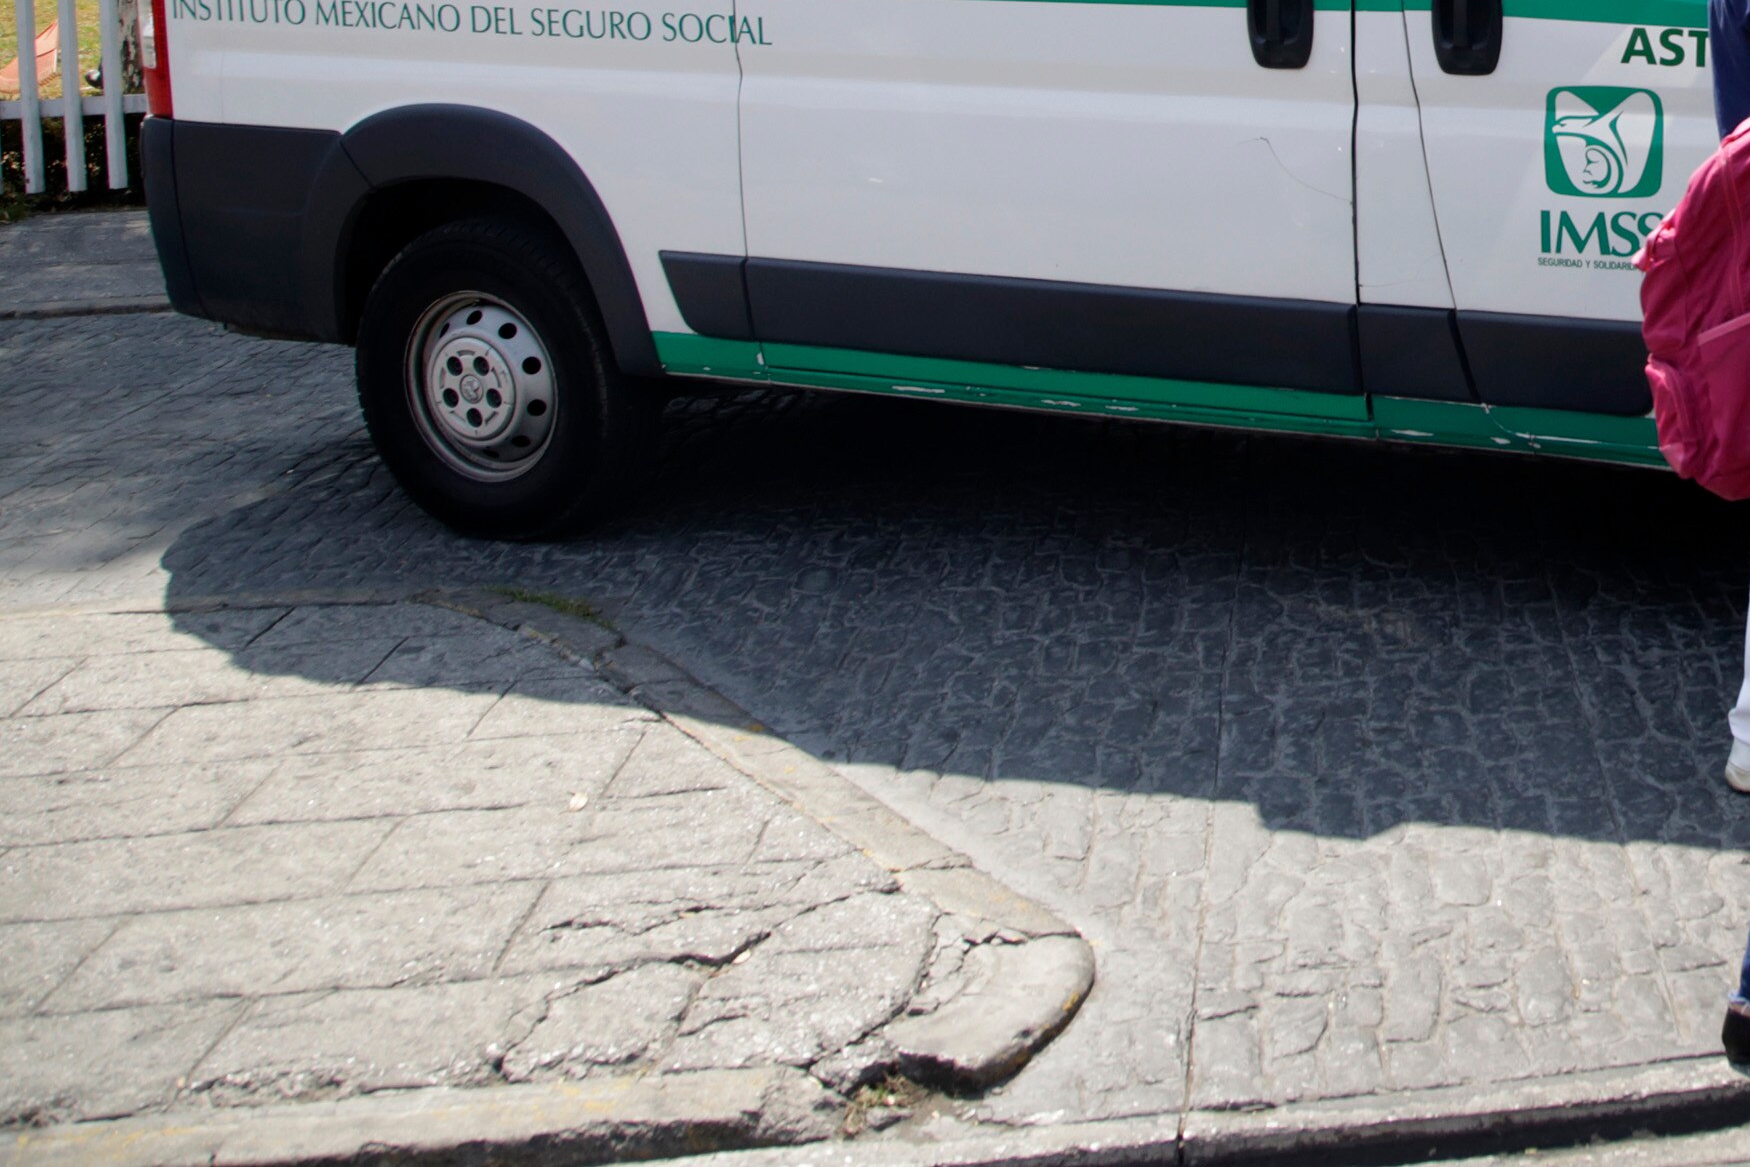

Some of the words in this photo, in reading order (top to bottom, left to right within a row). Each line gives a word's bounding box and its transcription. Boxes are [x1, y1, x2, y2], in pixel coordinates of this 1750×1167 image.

[315, 0, 460, 33] MEXICANO
[470, 5, 522, 36] DEL
[530, 7, 652, 41] SEGURO
[661, 12, 773, 46] SOCIAL
[1537, 257, 1583, 269] SEGURIDAD
[1585, 260, 1592, 269] Y
